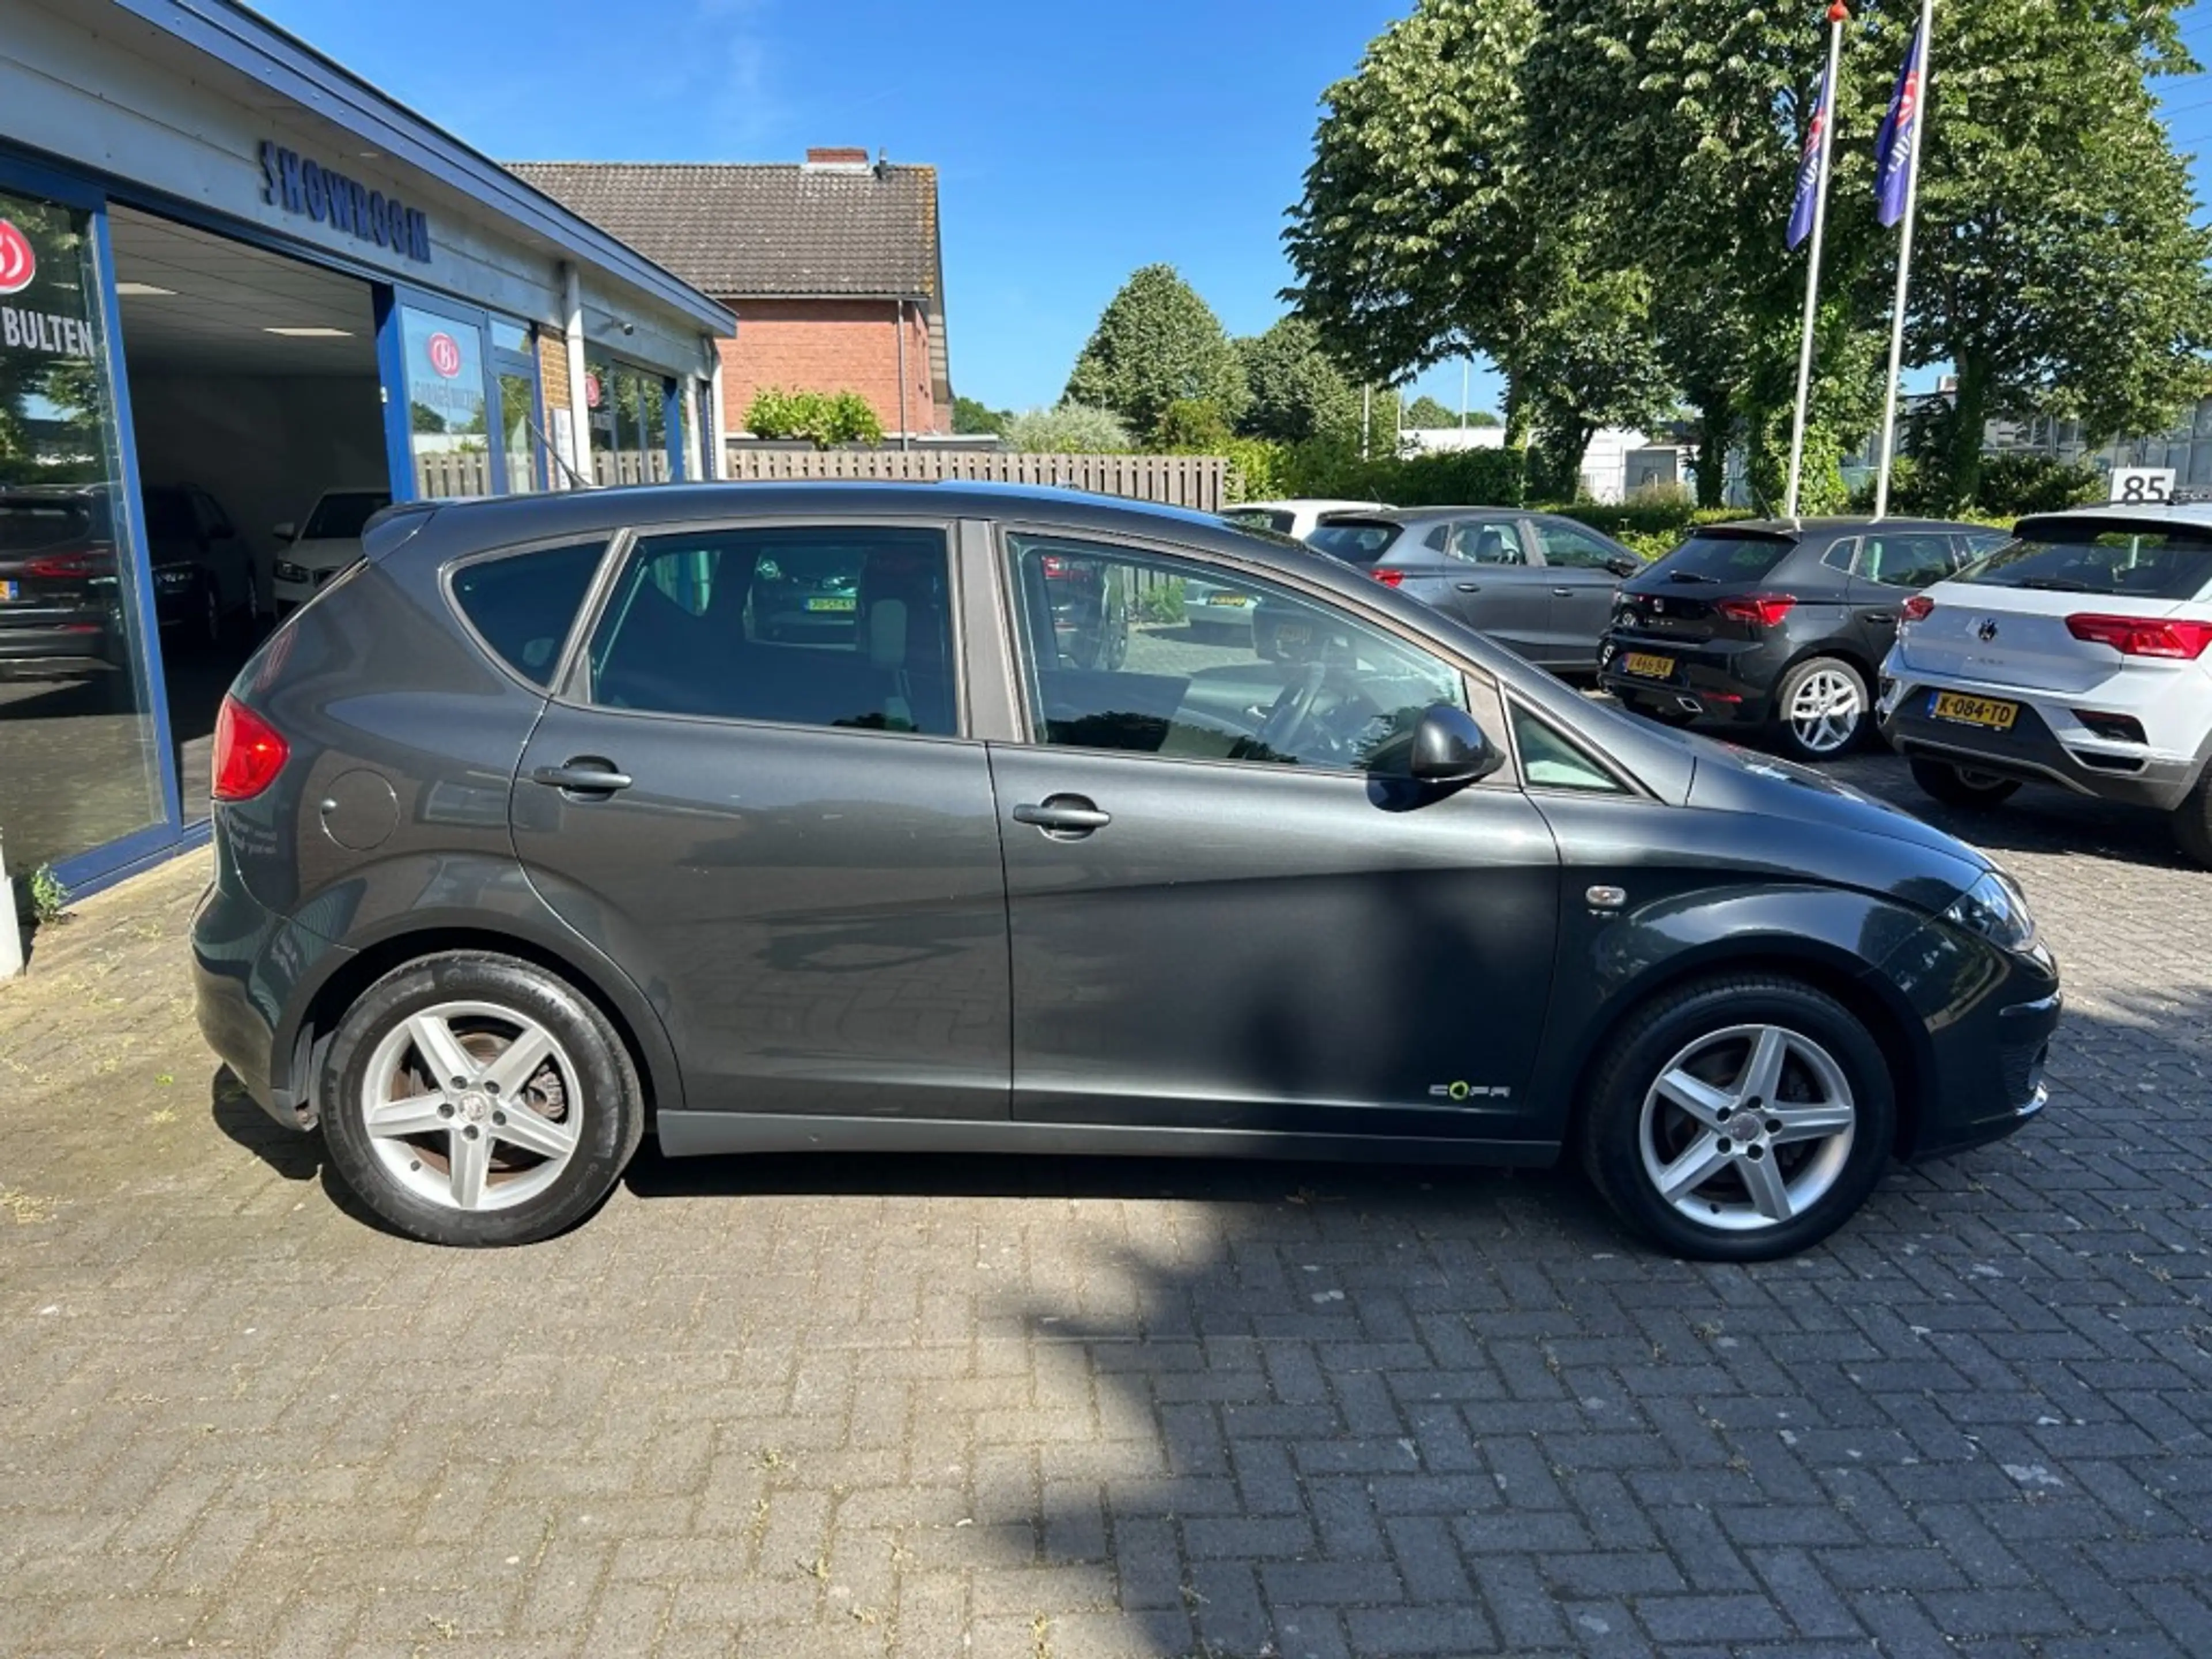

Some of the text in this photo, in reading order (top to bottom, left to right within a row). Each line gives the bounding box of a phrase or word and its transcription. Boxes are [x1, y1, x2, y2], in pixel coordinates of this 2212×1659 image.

[259, 140, 431, 263] SHOWROOM
[2, 306, 94, 358] BULTEN
[2122, 476, 2165, 503] 85
[1938, 695, 2011, 722] K-084-TD
